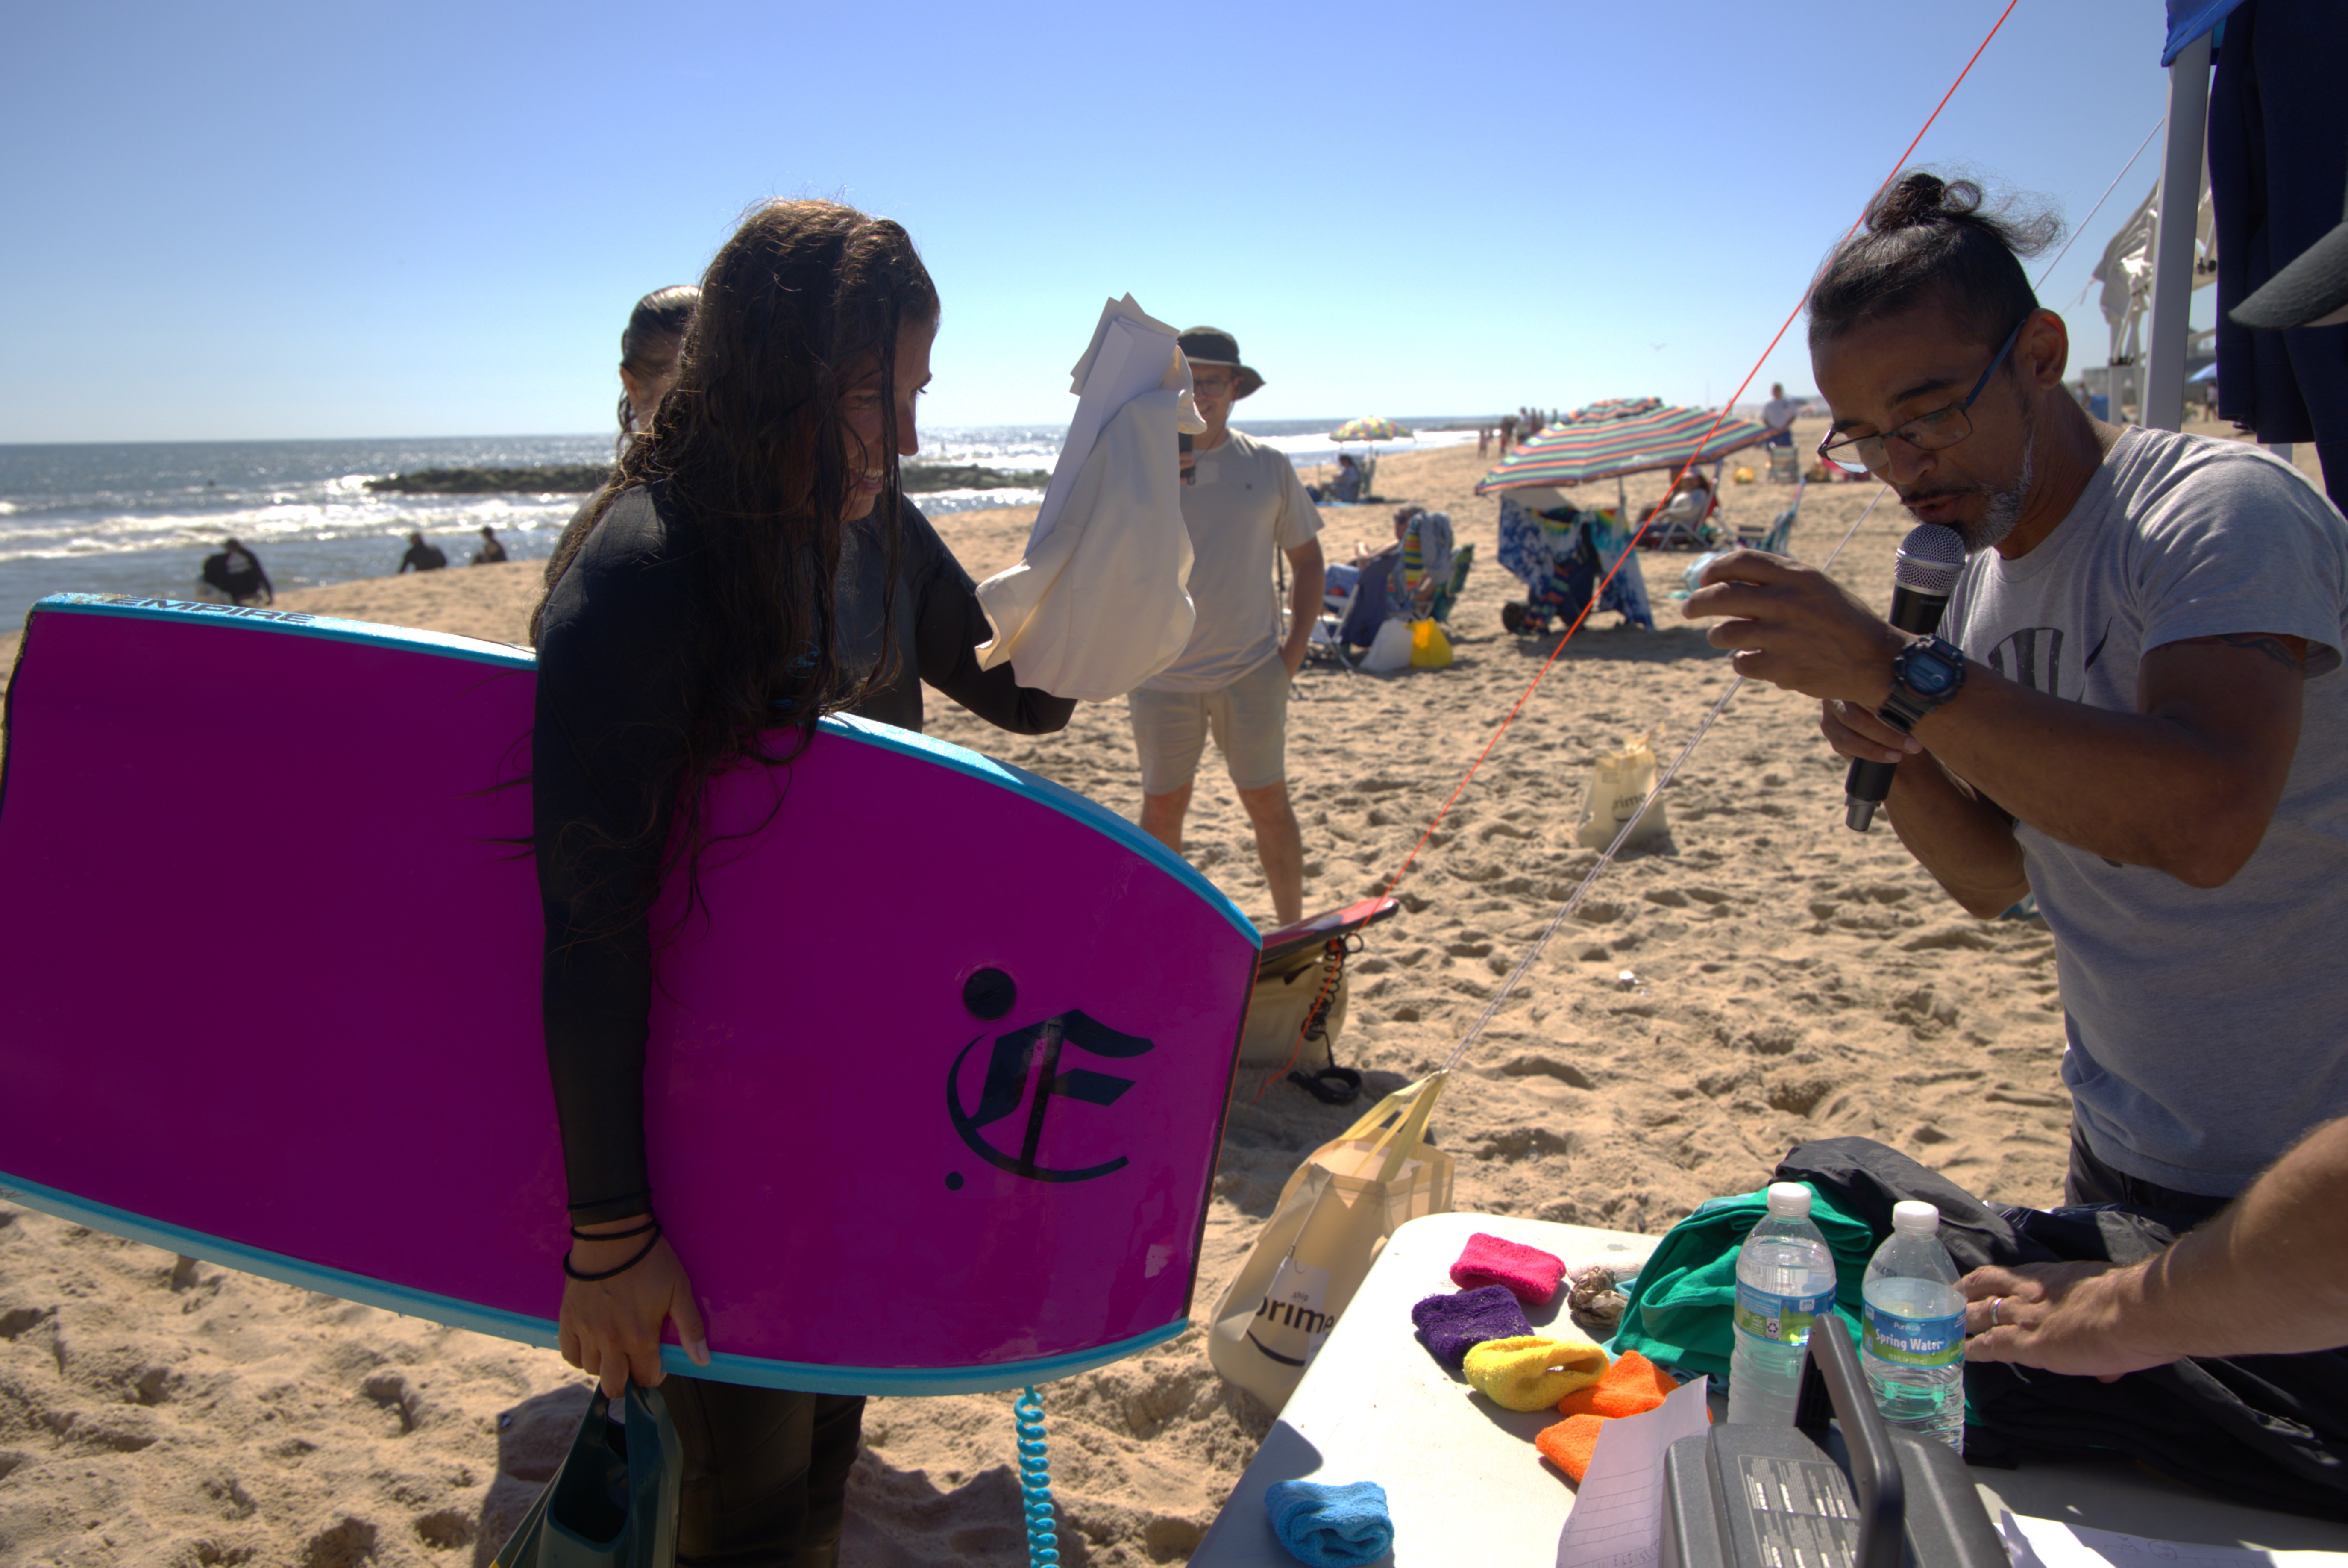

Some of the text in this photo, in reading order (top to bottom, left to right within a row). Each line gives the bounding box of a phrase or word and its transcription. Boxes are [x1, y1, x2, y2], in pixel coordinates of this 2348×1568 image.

[105, 597, 316, 624] EMPIRE
[1875, 1328, 1907, 1351] Spring
[1910, 1338, 1941, 1351] Water
